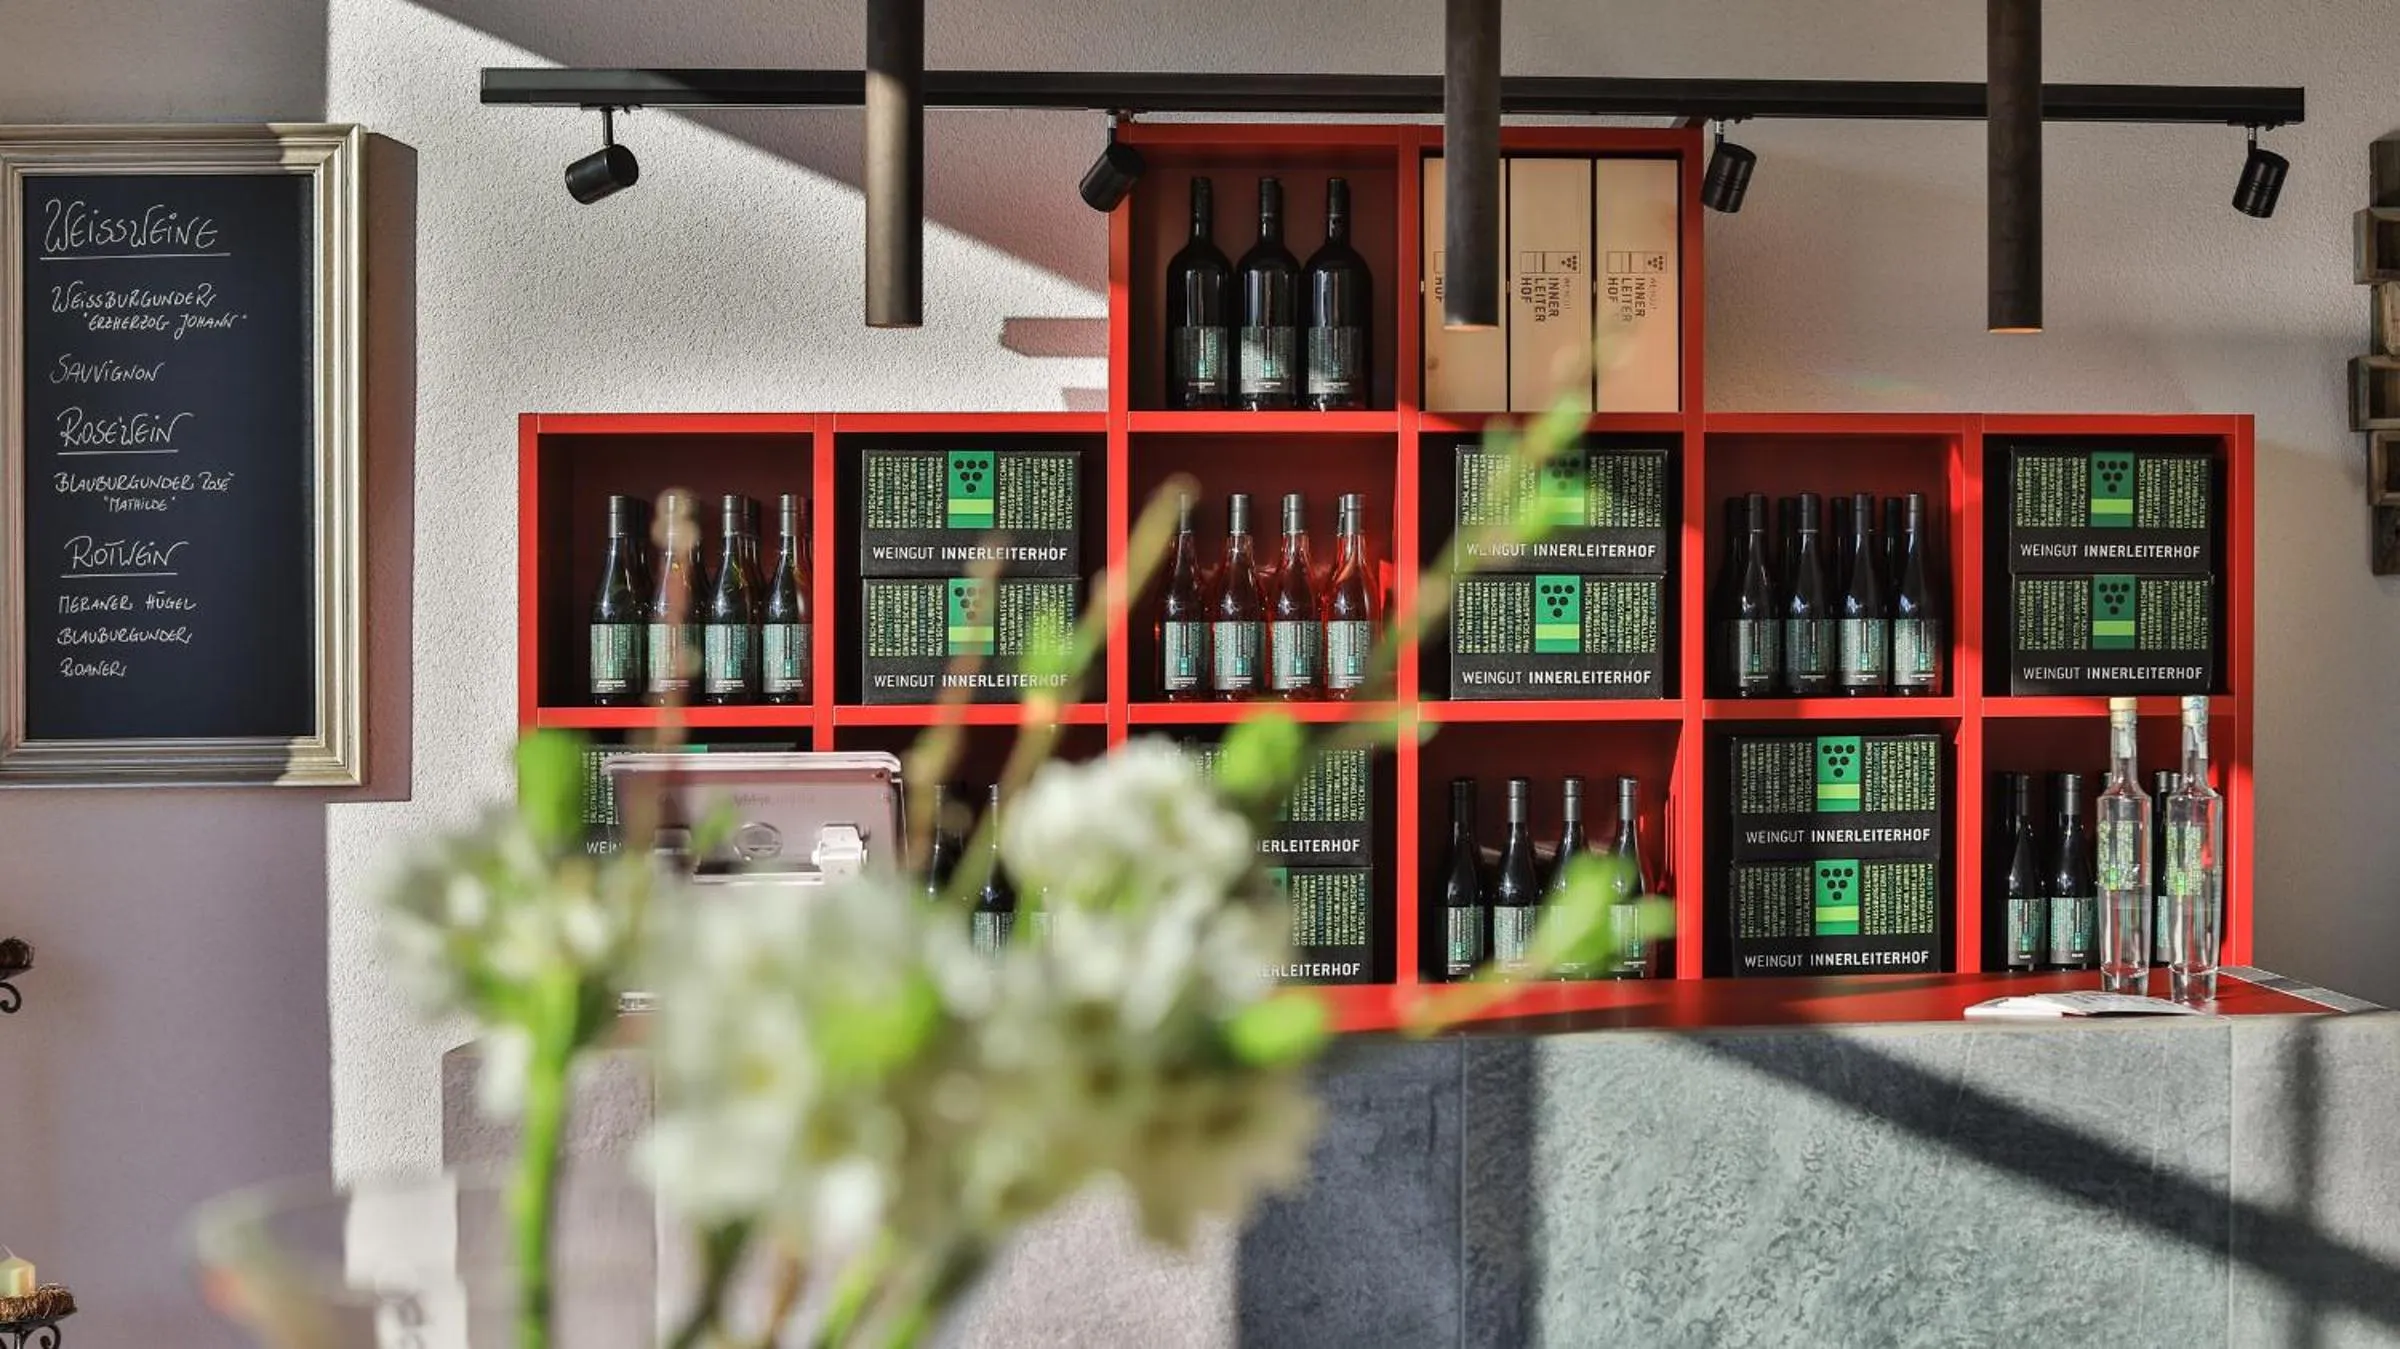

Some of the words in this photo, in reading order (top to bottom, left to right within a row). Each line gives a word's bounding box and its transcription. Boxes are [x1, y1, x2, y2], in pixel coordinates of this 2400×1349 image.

[1521, 277, 1533, 304] HOF
[1548, 277, 1560, 318] INNER
[1607, 277, 1619, 303] HOF
[1635, 277, 1646, 318] INNER
[1534, 277, 1546, 323] LEITER
[1621, 277, 1633, 323] LEITER
[872, 546, 935, 560] WEINGUT
[941, 546, 1068, 561] INNERLEITERHOF
[1533, 544, 1657, 558] INNERLEITERHOF
[2020, 543, 2078, 558] WEINGUT
[2084, 544, 2201, 559] INNERLEITERHOF
[873, 674, 936, 688] WEINGUT
[1462, 671, 1523, 685] WEINGUT
[1528, 671, 1652, 685] INNERLEITERHOF
[2023, 666, 2081, 680] WEINGUT
[2086, 666, 2204, 680] INNERLEITERHOF
[1745, 829, 1806, 845] WEINGUT
[1811, 828, 1932, 844] INNERLEITERHOF
[1744, 953, 1803, 969] WEINGUT
[1810, 950, 1930, 967] INNERLEITERHOF
